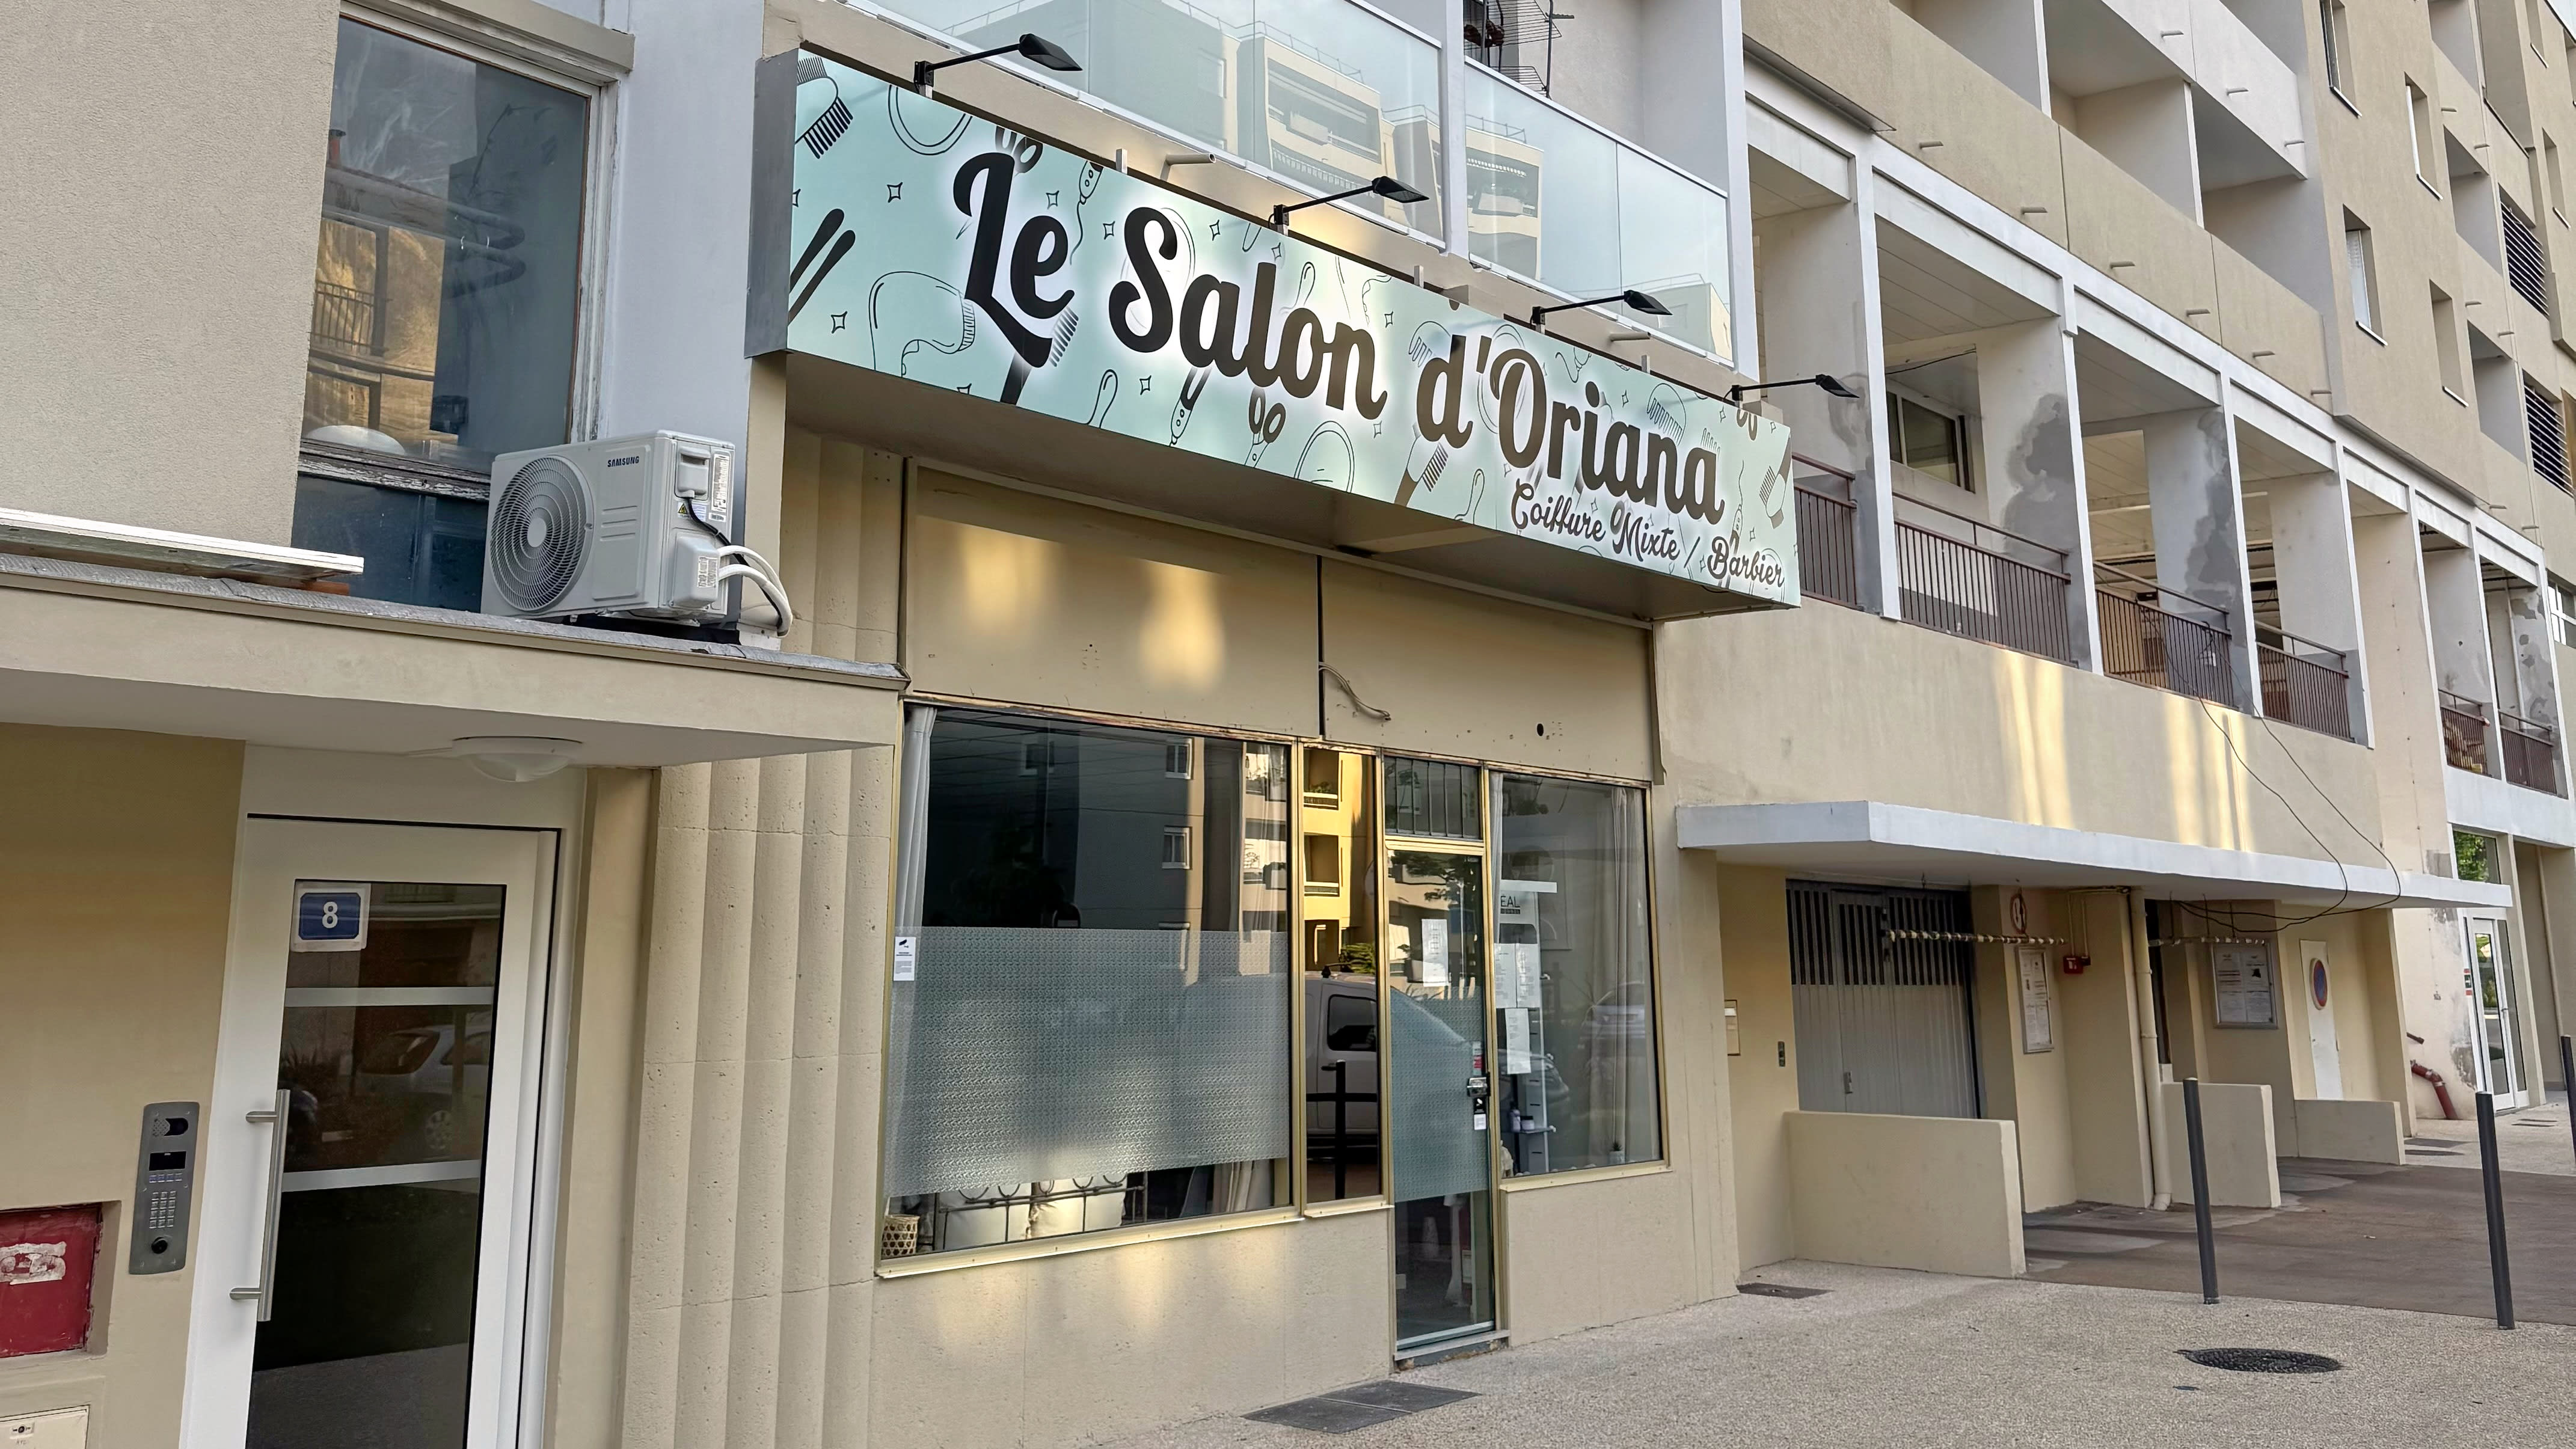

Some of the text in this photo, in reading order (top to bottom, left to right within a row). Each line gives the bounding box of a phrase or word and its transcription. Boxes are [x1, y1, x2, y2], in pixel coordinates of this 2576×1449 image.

[952, 152, 1725, 525] Le Salon d'Oriana
[607, 456, 640, 467] SAMSUNG
[1511, 478, 1785, 587] Coiffure Mixte / Barbier
[322, 901, 338, 929] 8
